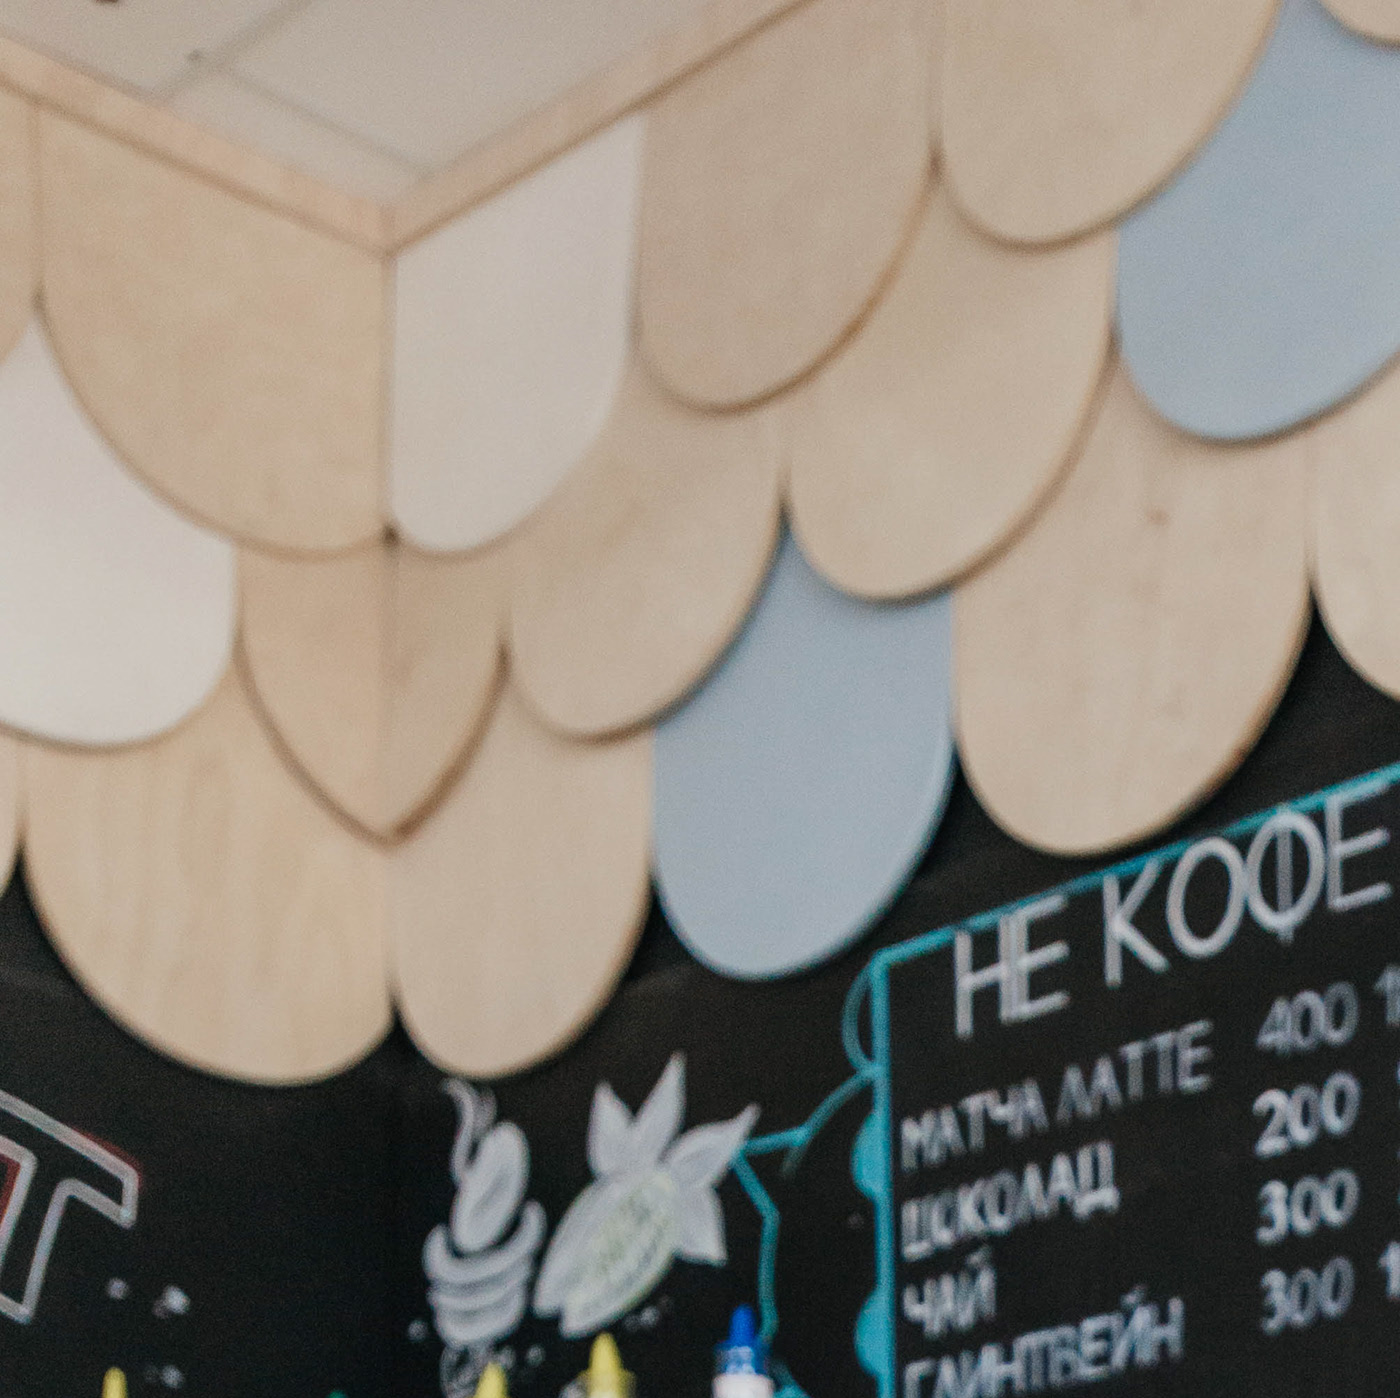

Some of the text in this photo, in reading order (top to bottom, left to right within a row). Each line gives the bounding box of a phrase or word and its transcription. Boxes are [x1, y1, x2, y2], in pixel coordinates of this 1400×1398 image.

[954, 783, 1391, 1038] НЕ КОФЕ
[901, 1078, 1048, 1172] МАТЧА
[1056, 1020, 1212, 1127] ЛАТТЕ
[1256, 981, 1359, 1055] 400
[902, 1140, 1120, 1262] ШОКОЛАД
[1253, 1071, 1361, 1157] 200
[903, 1248, 997, 1338] ЧАЙ
[1256, 1169, 1359, 1245] 300
[1261, 1256, 1354, 1334] 300
